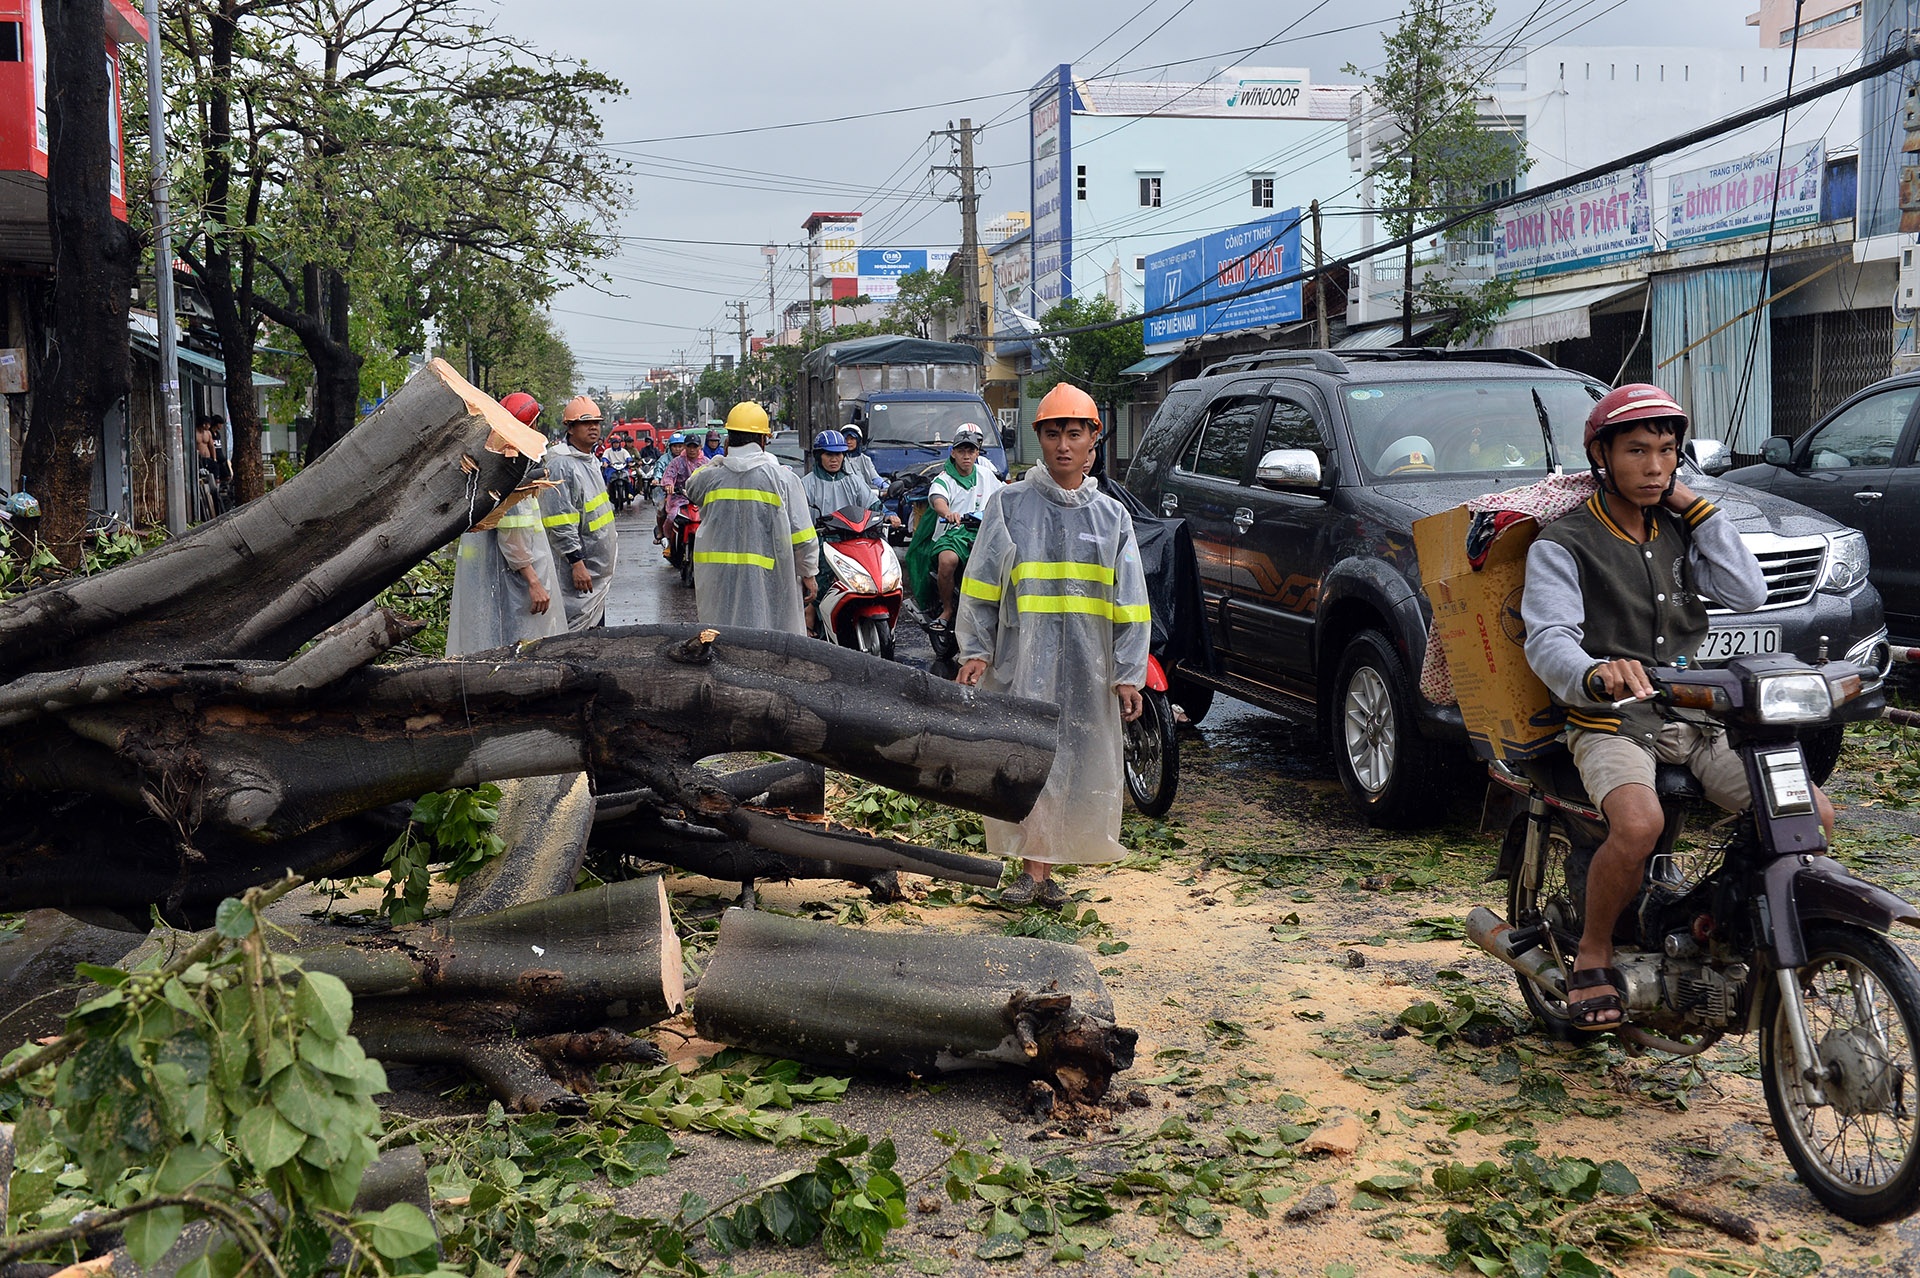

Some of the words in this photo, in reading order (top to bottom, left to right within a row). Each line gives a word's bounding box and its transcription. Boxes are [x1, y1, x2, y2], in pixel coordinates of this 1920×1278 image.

[1709, 166, 1731, 178] TRANG
[1686, 182, 1722, 219] BÌNH
[1726, 172, 1748, 212] HÀ
[1225, 234, 1243, 250] CÔNG
[1244, 231, 1252, 243] TY
[1253, 225, 1272, 241] TNHH
[1506, 211, 1546, 251] BÌNH
[1551, 198, 1575, 246] HÀ
[825, 237, 855, 252] HIỆP
[1218, 254, 1246, 288] NAM
[1150, 314, 1166, 337] THÉP
[1182, 314, 1197, 333] NAM
[1476, 613, 1497, 673] SENKO
[1695, 630, 1776, 657] -732.10
[1559, 801, 1583, 814] HONDA
